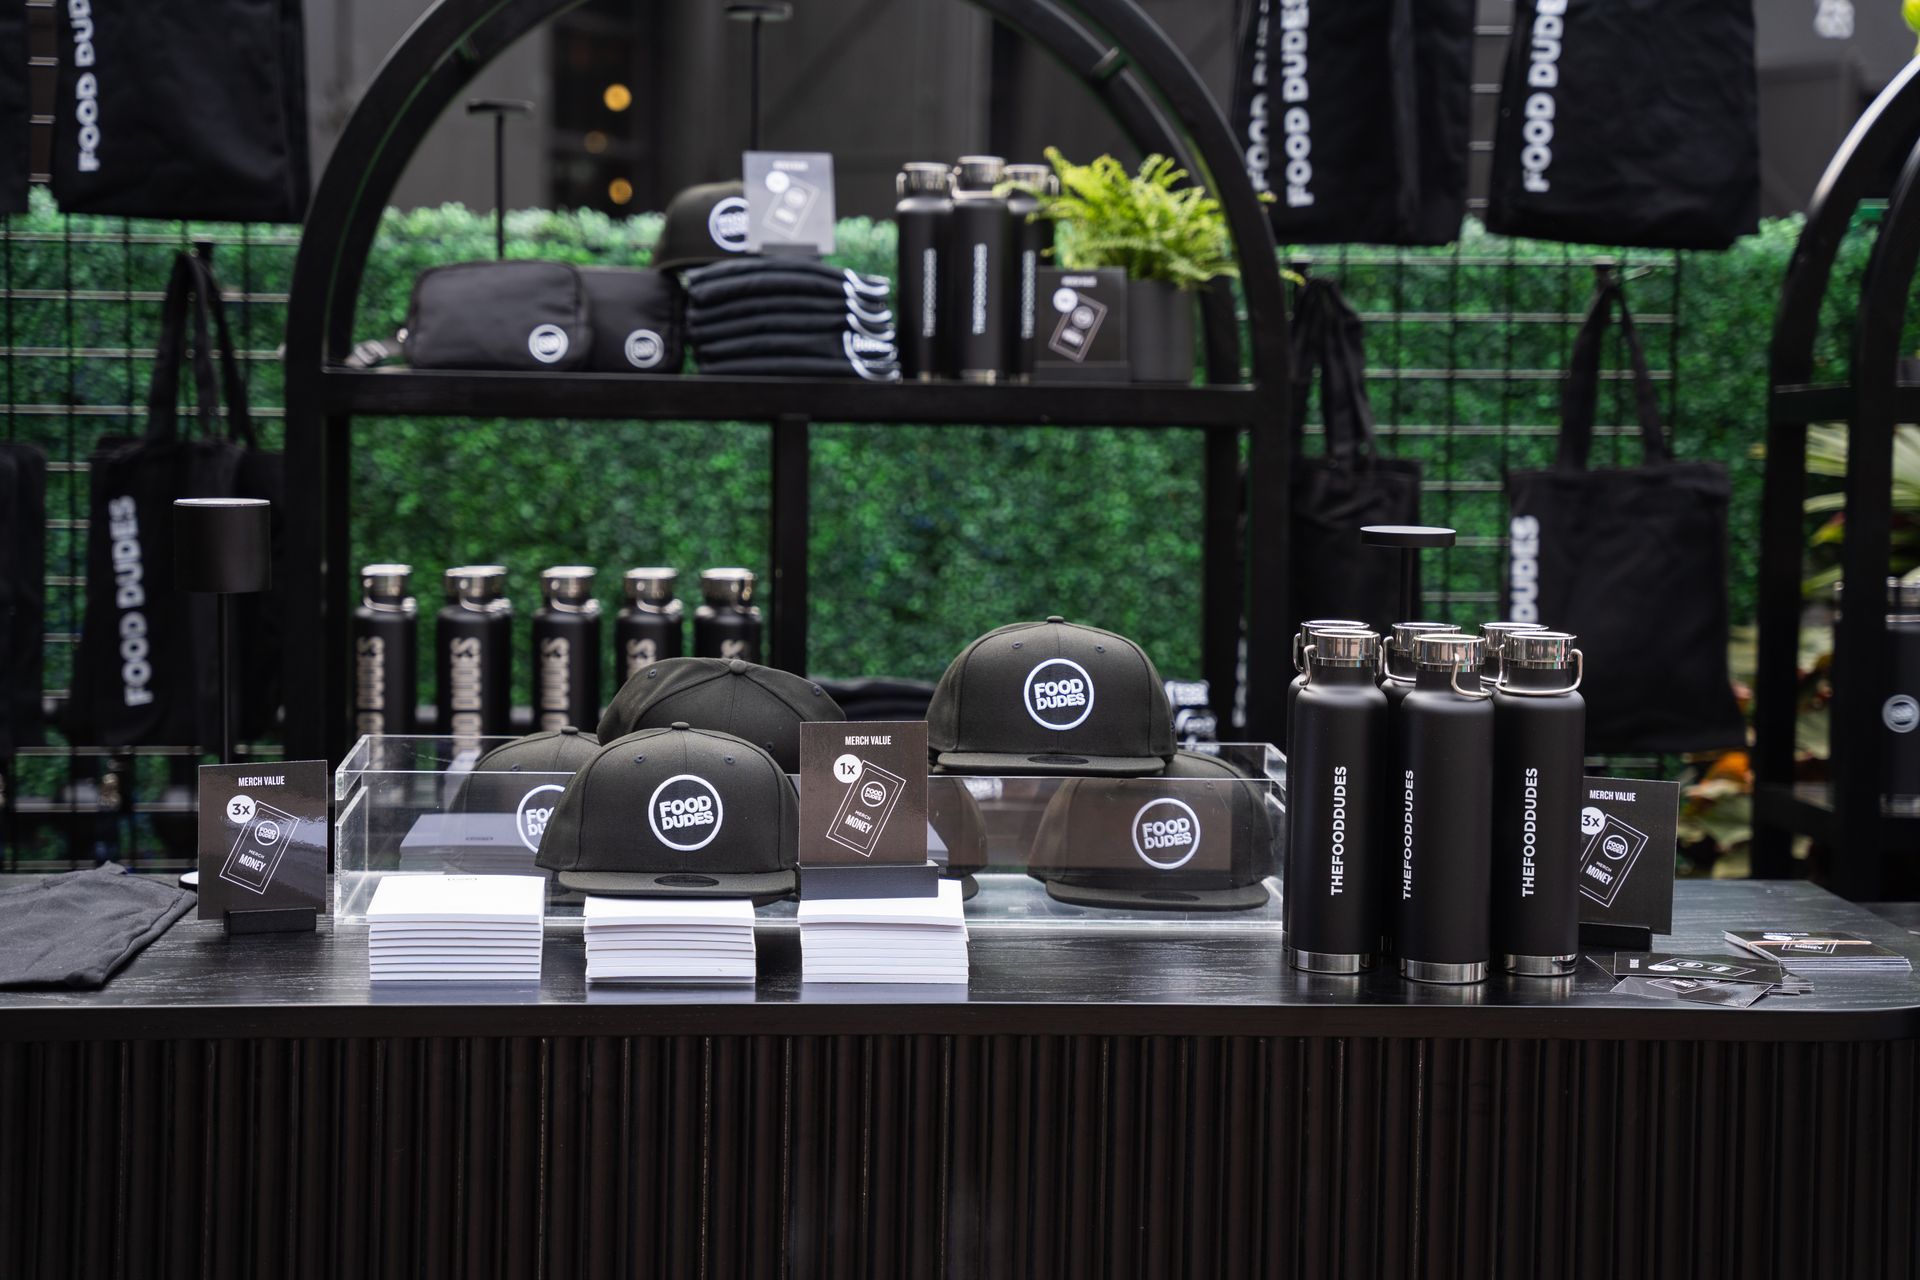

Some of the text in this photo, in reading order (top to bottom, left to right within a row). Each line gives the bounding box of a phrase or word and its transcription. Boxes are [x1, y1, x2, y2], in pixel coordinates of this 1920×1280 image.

[76, 72, 100, 172] FOOD
[1521, 92, 1556, 192] FOOD
[1284, 107, 1315, 208] FOOD
[108, 496, 154, 706] FOOD DUDES
[1034, 679, 1084, 699] FOOD
[1036, 692, 1086, 711] DUDES
[844, 735, 892, 746] MERCH VALUE
[840, 763, 855, 775] 1x
[238, 775, 286, 787] MERCH VALUE
[865, 786, 883, 797] FOOD
[1589, 789, 1637, 802] MERCH VALUE
[232, 803, 251, 816] 3x
[659, 795, 712, 818] FOOD
[661, 810, 714, 830] DUDES
[845, 814, 873, 835] MONEY
[1142, 817, 1190, 838] FOOD
[1582, 814, 1600, 827] 3x
[1144, 831, 1192, 849] DUDES
[1330, 766, 1347, 896] THEFOODDUDES
[1403, 770, 1414, 900] THEFOODDUDES
[1522, 768, 1538, 897] THEFOODDUDES
[238, 853, 267, 873] MONEY
[248, 849, 265, 859] MERCH
[1585, 864, 1614, 886] MONEY
